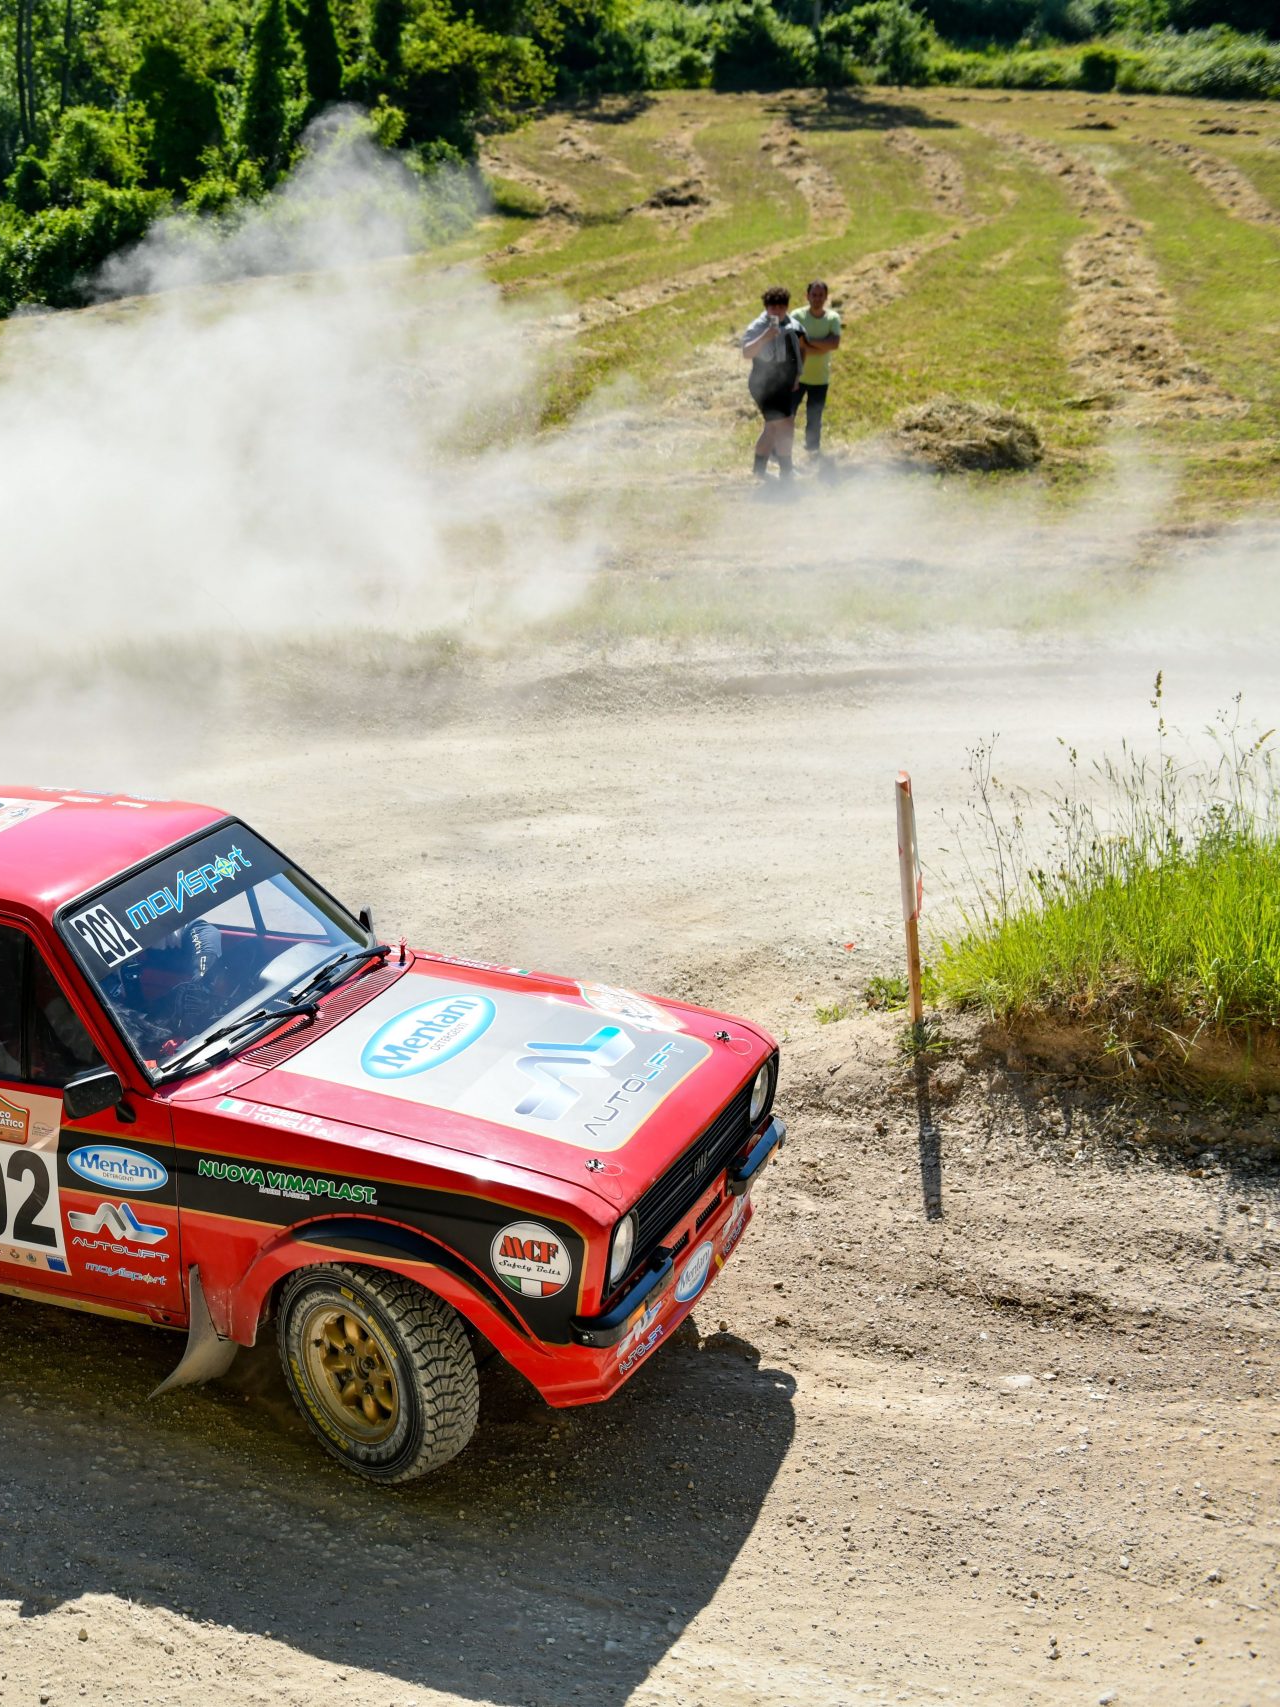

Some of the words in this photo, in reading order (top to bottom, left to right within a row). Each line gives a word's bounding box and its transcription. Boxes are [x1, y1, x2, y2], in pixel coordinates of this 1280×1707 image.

[125, 844, 252, 931] movisport
[74, 908, 133, 966] 202
[368, 998, 479, 1070] Mentani
[429, 1022, 469, 1052] DETERGENTI
[582, 1041, 685, 1137] AUTOLIFT
[80, 1152, 158, 1180] Mentani
[102, 1171, 134, 1182] DETERGENTI
[198, 1159, 265, 1186] NUOVA
[267, 1171, 377, 1205] VIMAPLAST
[72, 1236, 170, 1262] AUTOLIFT
[499, 1235, 559, 1265] MCF
[85, 1262, 167, 1286] movisport
[498, 1259, 533, 1272] Safety
[536, 1264, 561, 1276] Belts
[618, 1323, 664, 1375] AUTOLIFT
